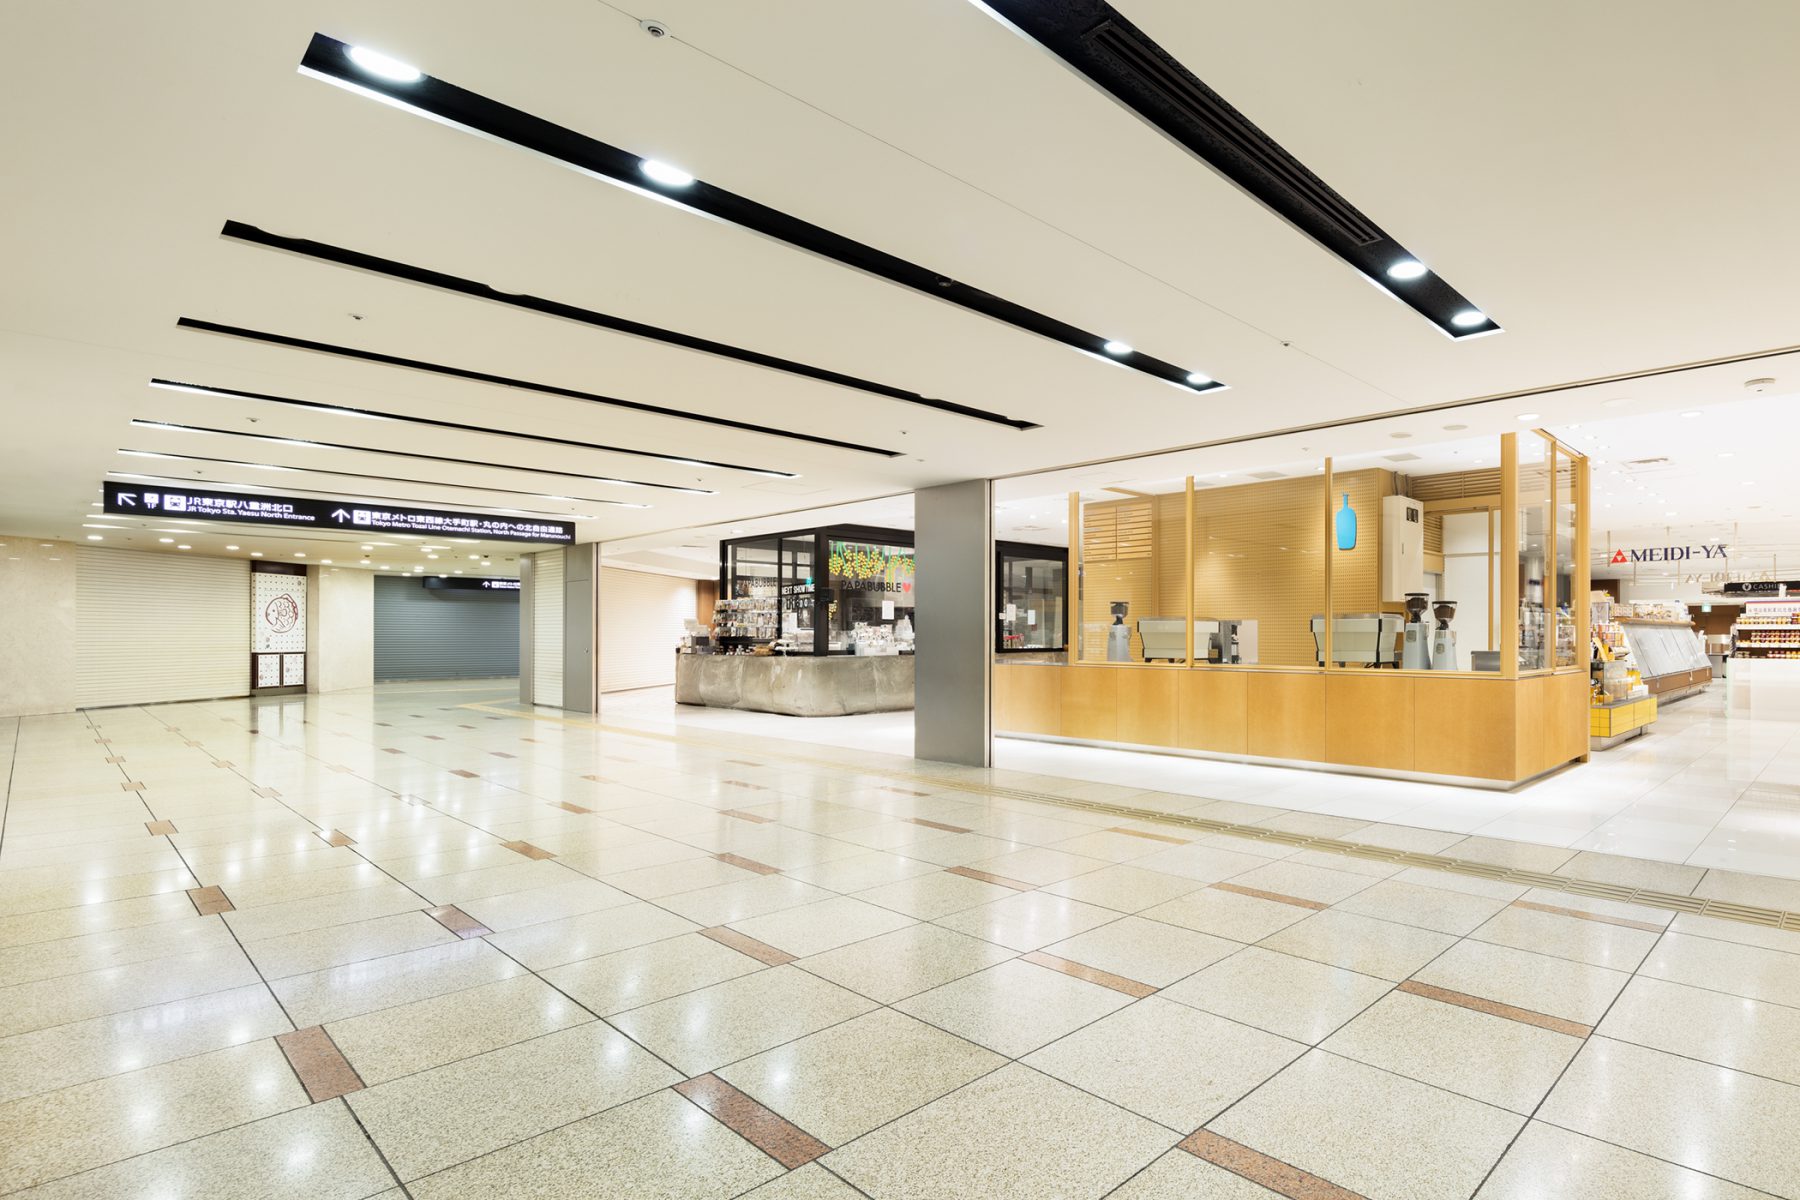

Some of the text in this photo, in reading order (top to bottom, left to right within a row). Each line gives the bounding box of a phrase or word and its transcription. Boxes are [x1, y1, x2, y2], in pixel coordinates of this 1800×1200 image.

[187, 496, 294, 513] JR東京駅八重洲北口
[198, 506, 221, 515] Tokyo
[222, 508, 236, 516] Sta.
[237, 509, 260, 517] Yaesu
[261, 511, 282, 519] North
[284, 512, 316, 521] Entrance
[372, 519, 391, 528] Tokyo
[510, 530, 531, 538] Passage
[1630, 544, 1728, 562] MEIDI-YA
[793, 584, 806, 594] SHOW
[841, 580, 902, 593] PAPABUBBLE
